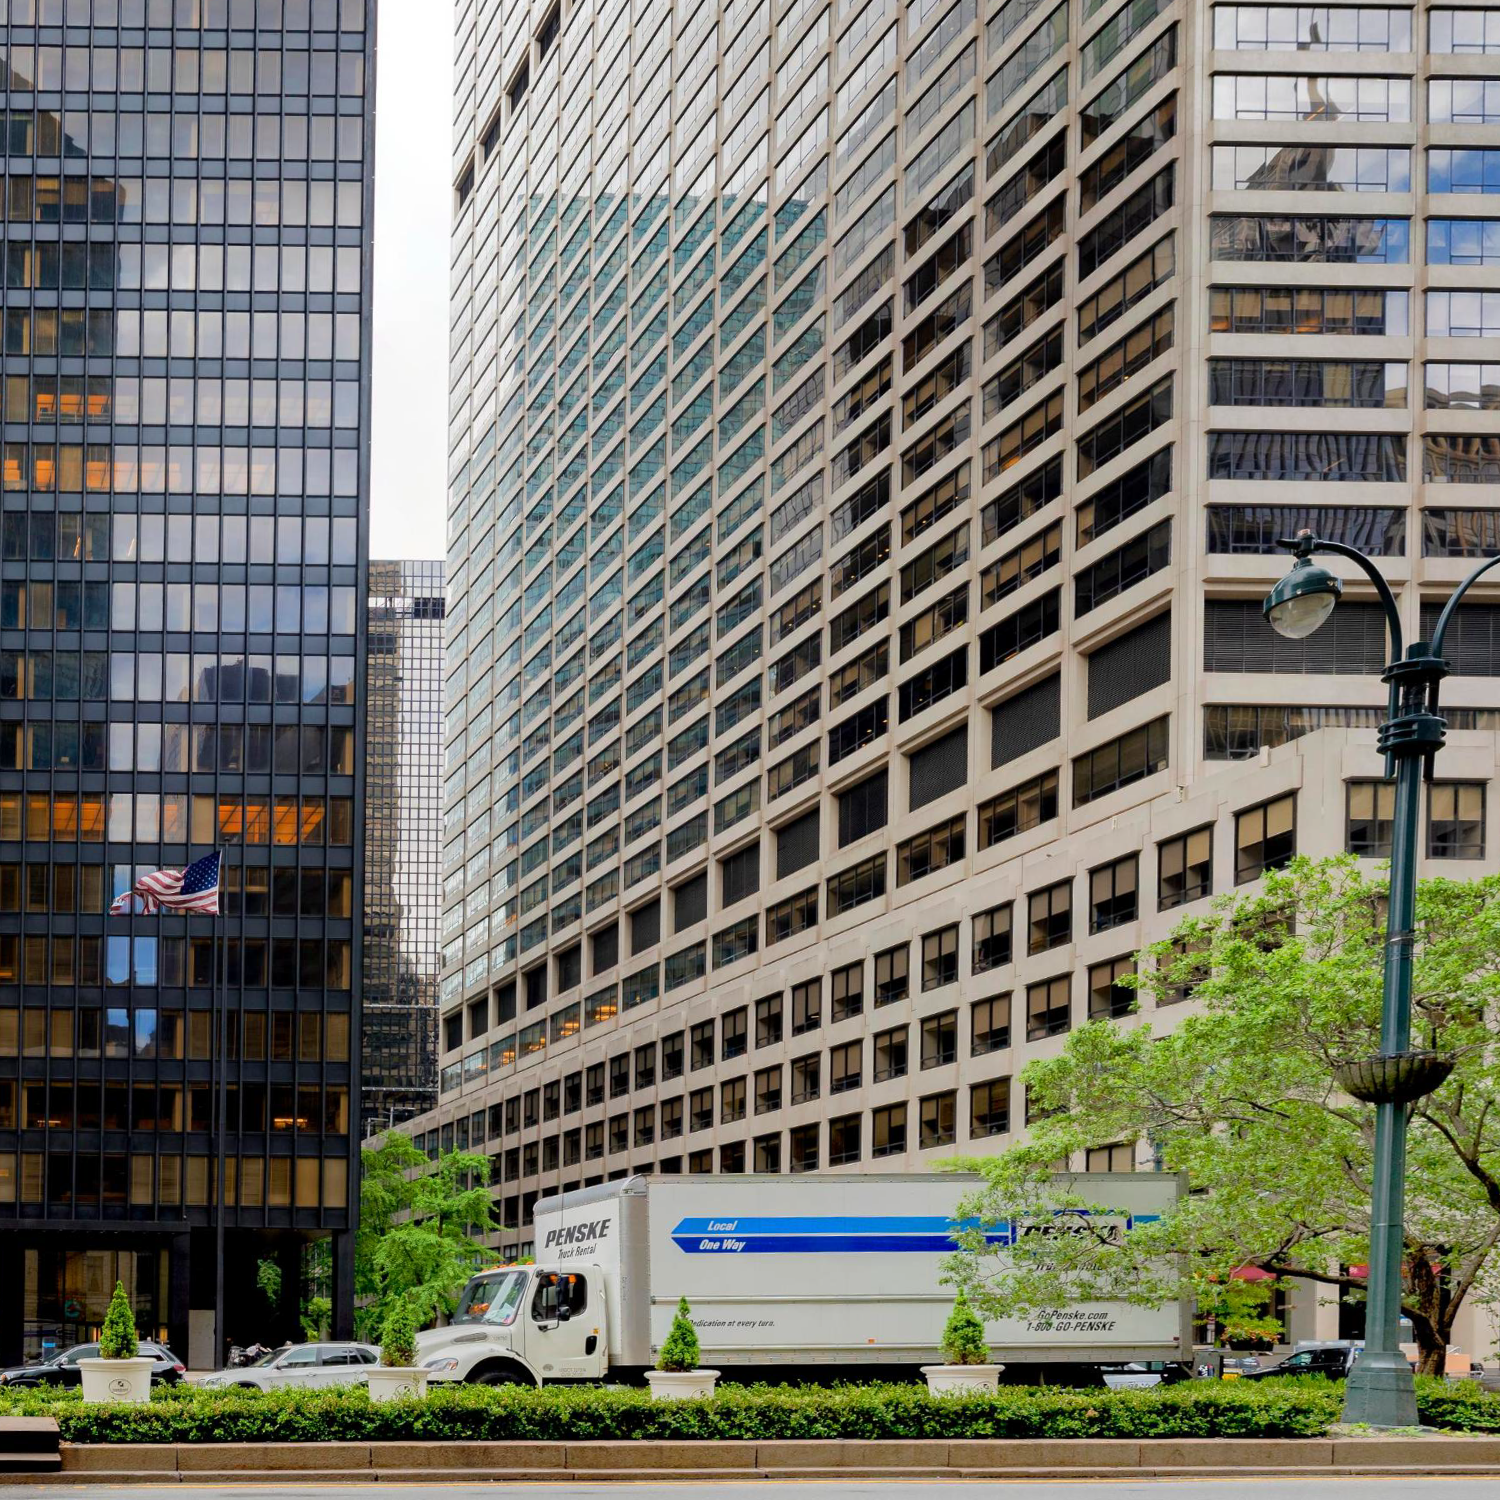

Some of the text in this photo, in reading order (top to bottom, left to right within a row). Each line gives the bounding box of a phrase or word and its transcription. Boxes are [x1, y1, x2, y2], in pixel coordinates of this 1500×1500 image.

[707, 1220, 738, 1231] Local
[544, 1218, 611, 1248] PENSKE
[558, 1243, 597, 1259] Truck Rental
[699, 1239, 746, 1252] One Way
[1038, 1311, 1108, 1320] GoPenske.com
[737, 1320, 758, 1328] every
[1027, 1321, 1116, 1331] 1-800-GO-PENSKE
